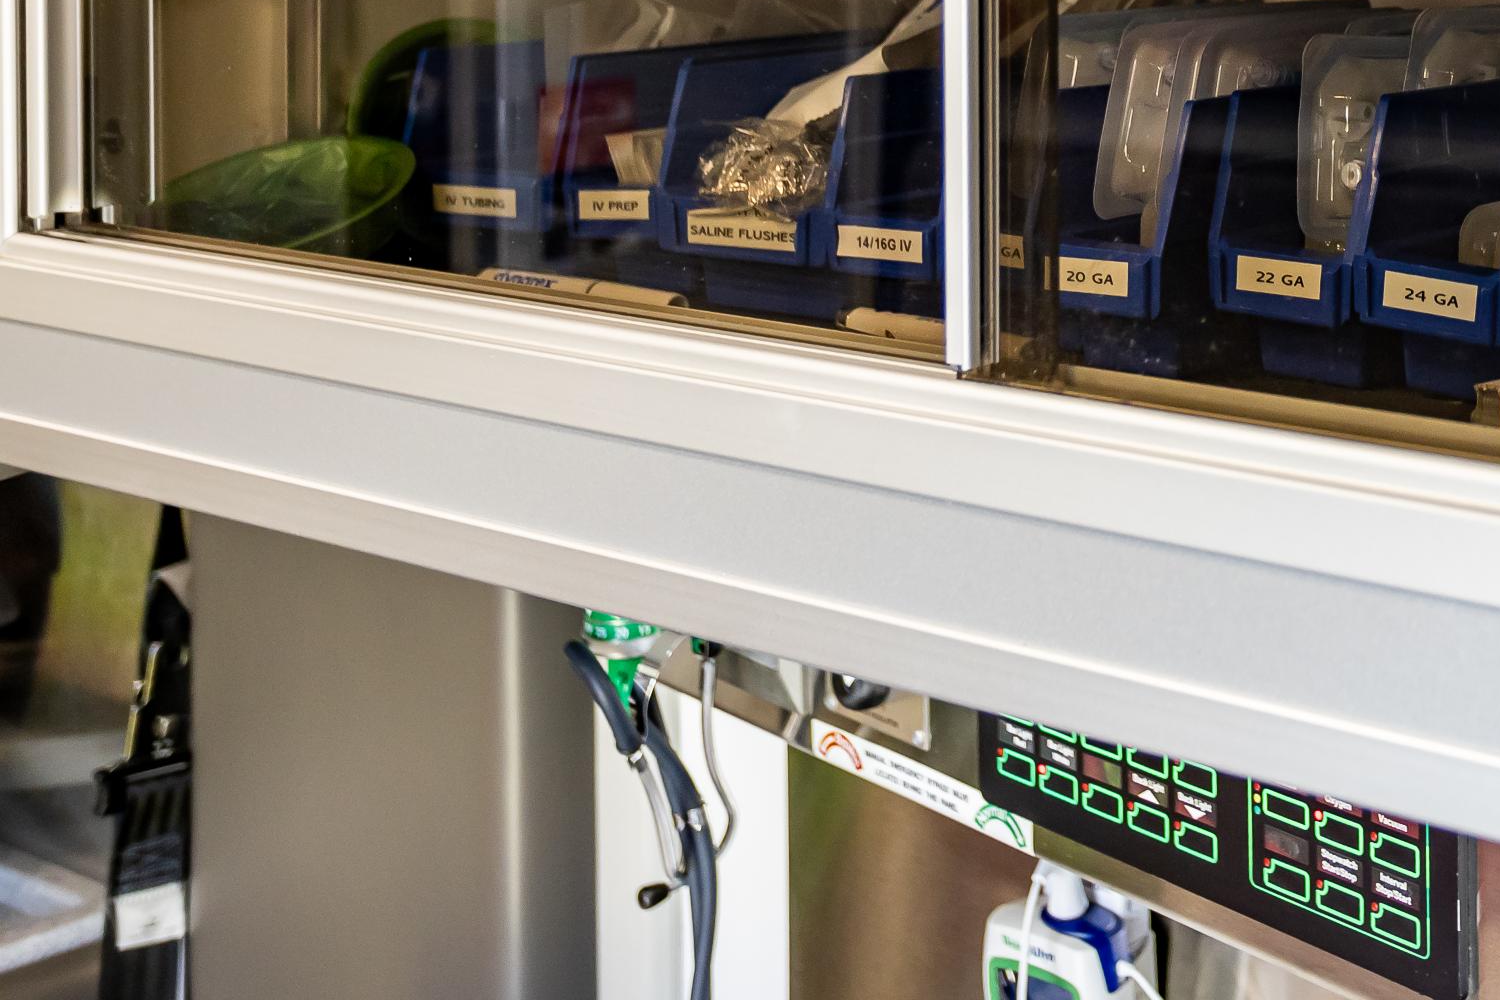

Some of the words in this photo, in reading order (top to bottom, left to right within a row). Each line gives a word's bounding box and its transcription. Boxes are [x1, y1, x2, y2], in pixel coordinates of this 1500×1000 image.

[462, 196, 504, 209] TUBING
[592, 201, 603, 211] IV
[608, 200, 639, 212] PREP
[690, 224, 734, 239] SALINE
[738, 228, 795, 244] FLUSHES
[857, 235, 897, 251] 14/16G
[899, 239, 912, 252] IV
[1066, 270, 1085, 283] 20
[1092, 272, 1114, 286] GA
[1256, 270, 1275, 284] 22
[1281, 274, 1305, 288] GA
[1404, 287, 1426, 302] 24
[1433, 292, 1459, 309] GA
[1378, 814, 1408, 833] Vacuum
